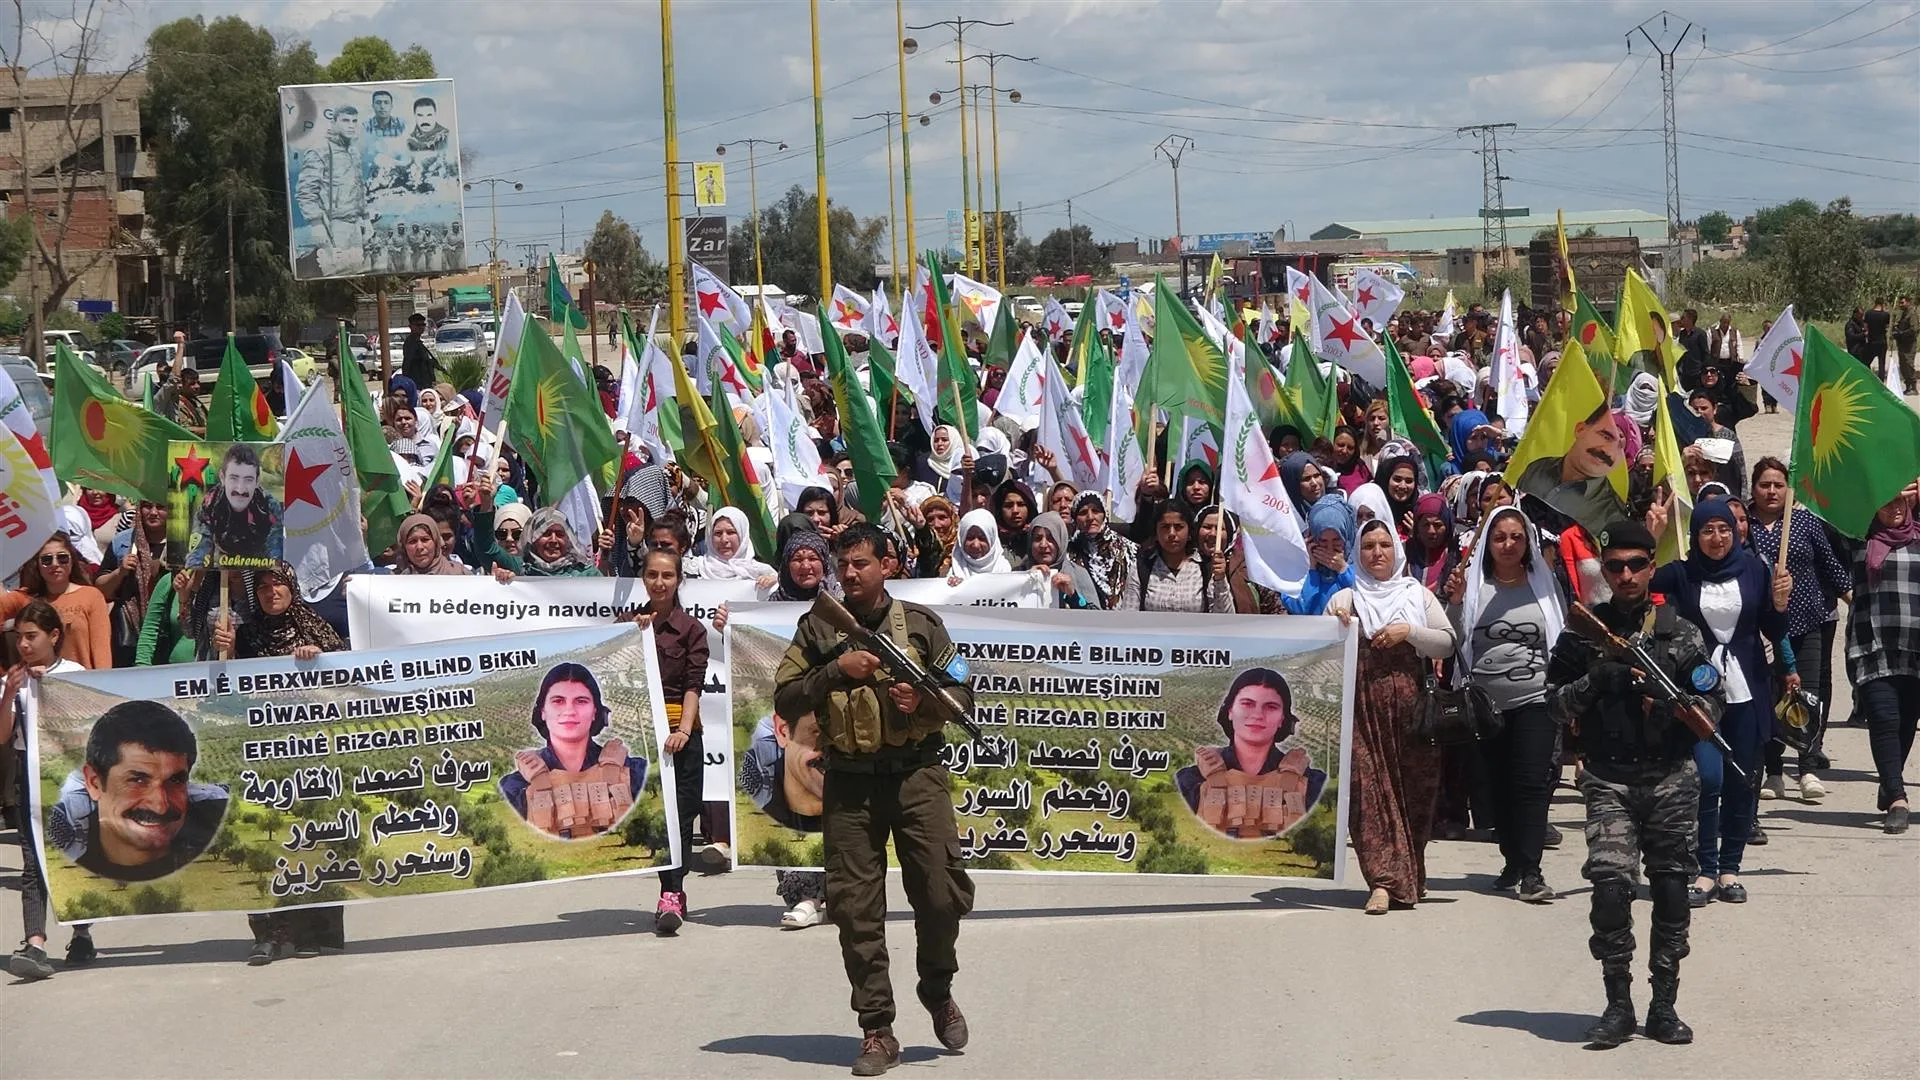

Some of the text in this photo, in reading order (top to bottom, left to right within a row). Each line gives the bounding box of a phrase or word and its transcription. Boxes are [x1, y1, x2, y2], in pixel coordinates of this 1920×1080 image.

[690, 237, 726, 252] Zar
[332, 446, 351, 477] PYD
[1262, 494, 1290, 515] 2003
[219, 554, 276, 568] Qehreman
[388, 598, 421, 613] Em
[430, 598, 540, 620] bêdengiya
[175, 679, 208, 698] EM
[216, 673, 231, 696] Ê
[238, 661, 394, 694] BERXWEDANÊ
[248, 703, 341, 727] DÎWARA
[244, 732, 329, 760] EFRÎNÊ
[1028, 738, 1102, 770] نصعد
[1108, 734, 1170, 778] سوف
[241, 749, 491, 811] سوف نصعد المقاومة
[955, 779, 1130, 820] ونحطم السور
[284, 799, 459, 851] ونحطم السور
[1033, 821, 1138, 861] وسنحرر
[271, 842, 473, 896] وسنحرر عفرين
